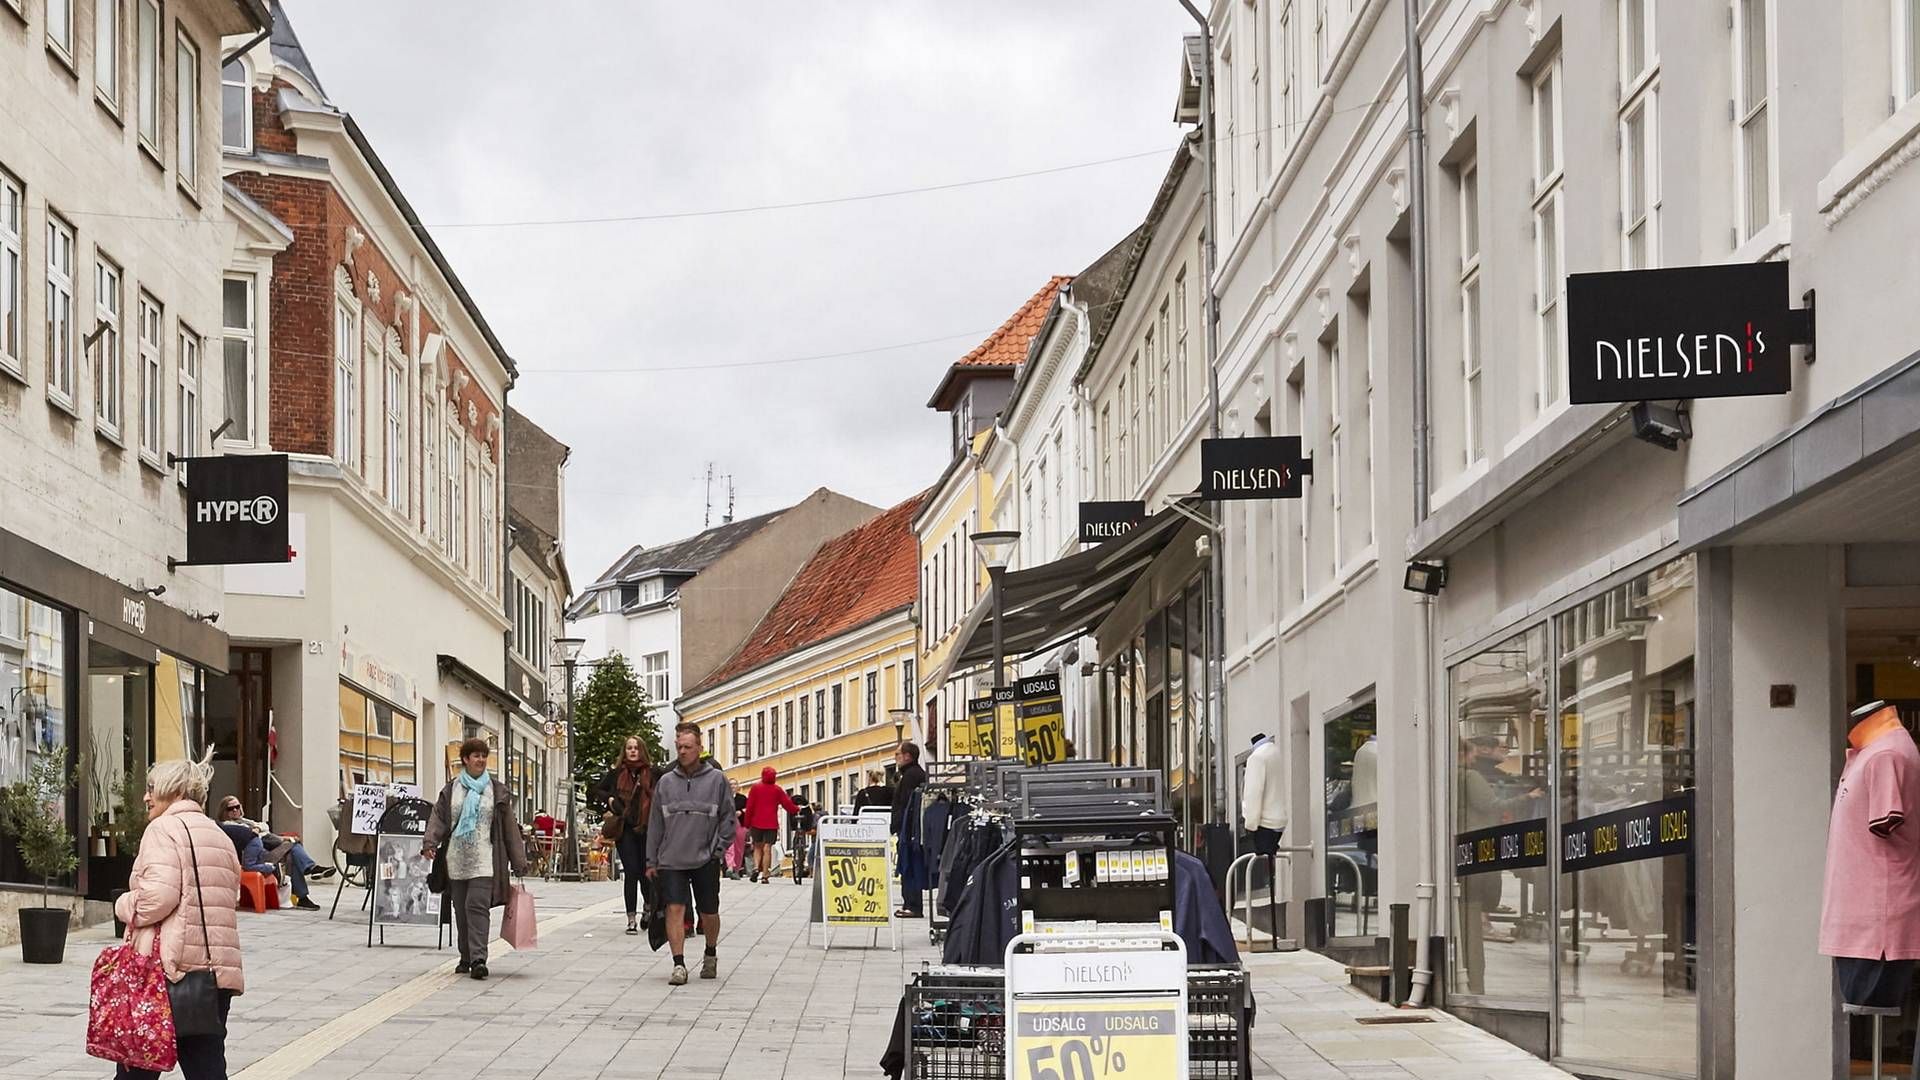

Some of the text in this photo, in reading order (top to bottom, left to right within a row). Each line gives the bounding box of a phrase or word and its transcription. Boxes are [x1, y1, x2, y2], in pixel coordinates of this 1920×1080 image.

[308, 640, 324, 655] 21
[1022, 679, 1056, 695] UDSALG
[979, 732, 995, 755] 5
[1001, 736, 1017, 746] 29
[1564, 809, 1688, 861] UDSALG UDSALG UDSALG UDSALG
[828, 856, 867, 889] 50%
[857, 876, 884, 897] 40%
[834, 894, 859, 914] 30%
[1033, 1015, 1159, 1033] UDSALG UDSALG
